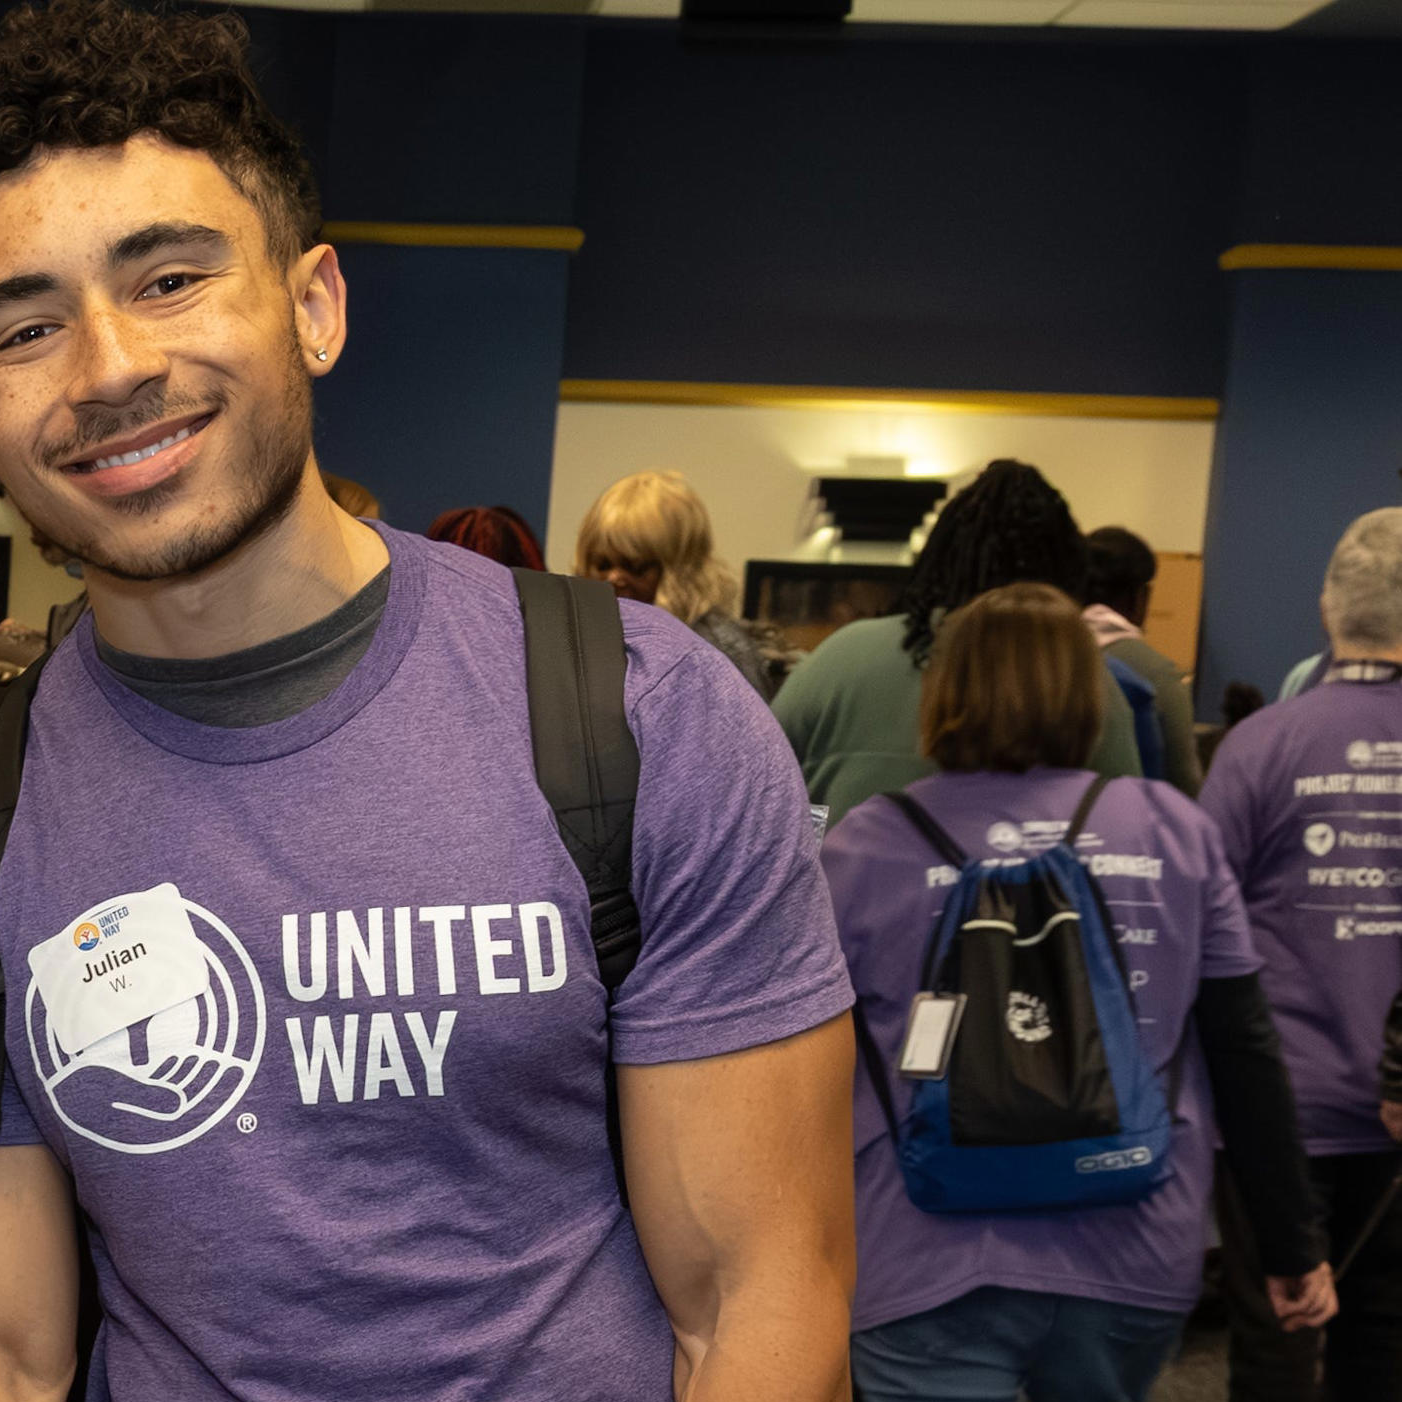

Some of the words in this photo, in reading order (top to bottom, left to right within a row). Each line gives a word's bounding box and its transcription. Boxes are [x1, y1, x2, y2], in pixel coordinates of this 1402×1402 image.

[98, 906, 129, 928] UNITED
[102, 922, 121, 938] WAY
[82, 942, 147, 983] Julian
[281, 901, 568, 1002] UNITED
[109, 975, 133, 993] W.
[284, 1010, 458, 1105] WAY
